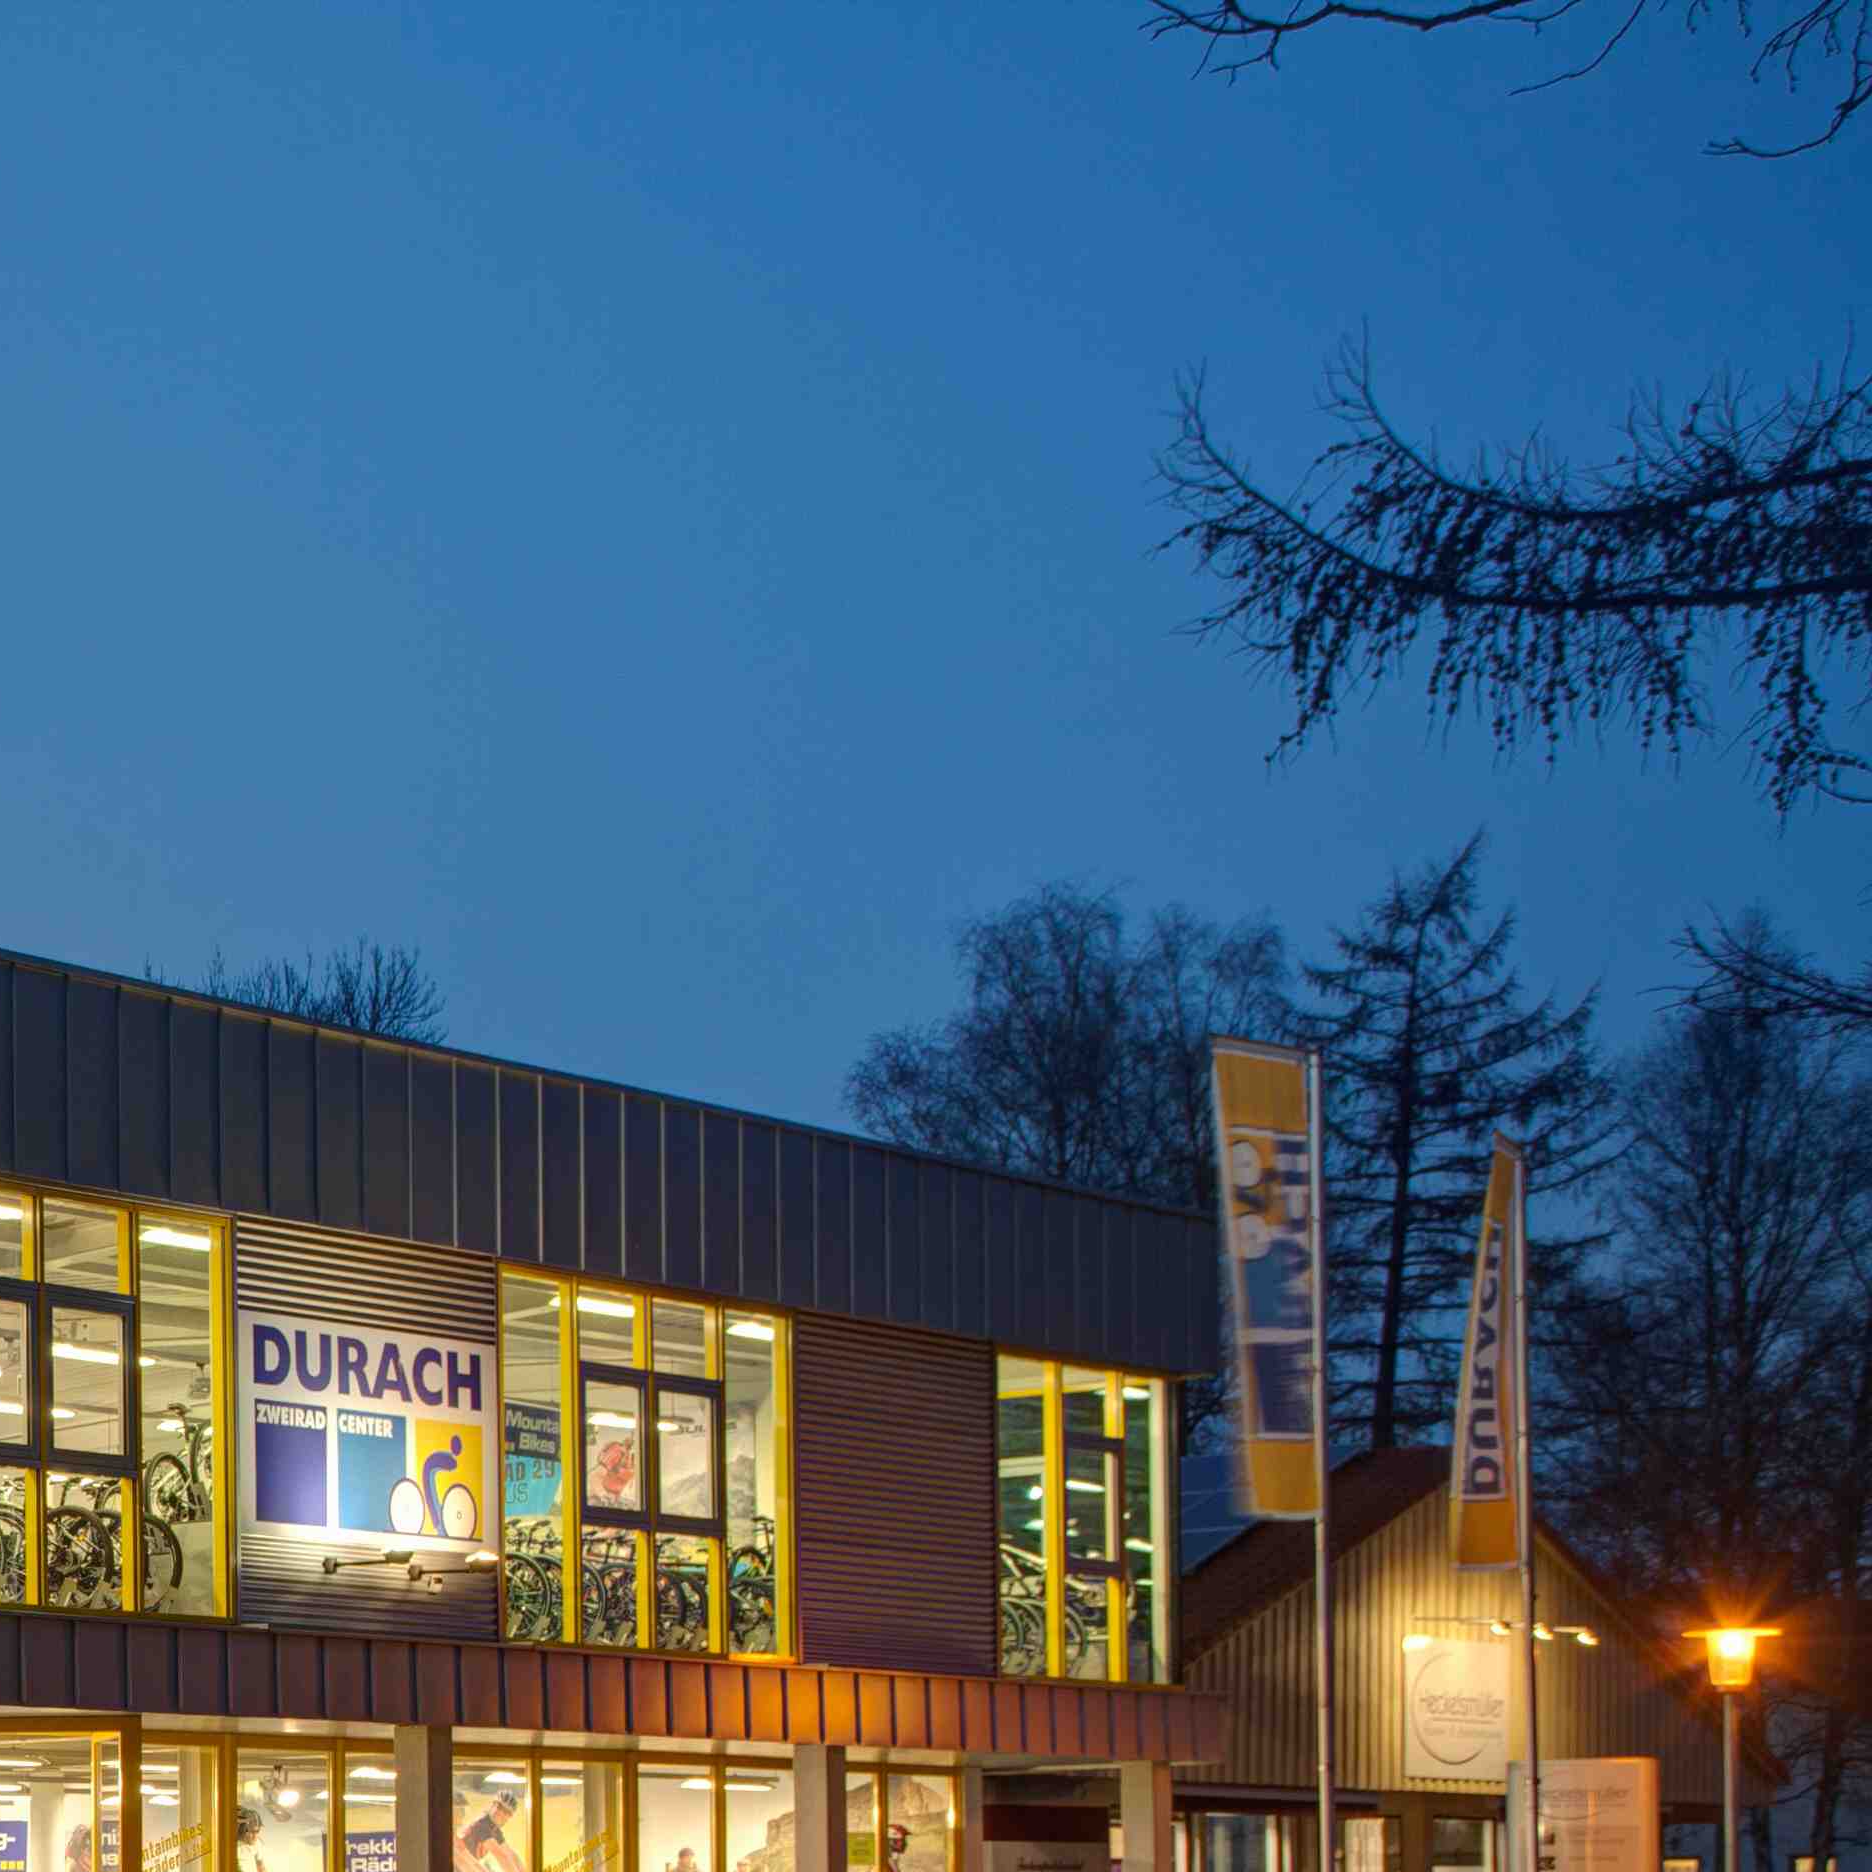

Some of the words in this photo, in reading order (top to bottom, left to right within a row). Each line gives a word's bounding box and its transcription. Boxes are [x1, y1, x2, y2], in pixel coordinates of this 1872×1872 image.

[253, 1324, 482, 1411] DURACH
[256, 1403, 327, 1431] ZWEIRAD
[337, 1415, 394, 1439] CENTER
[519, 1432, 556, 1454] Bikes
